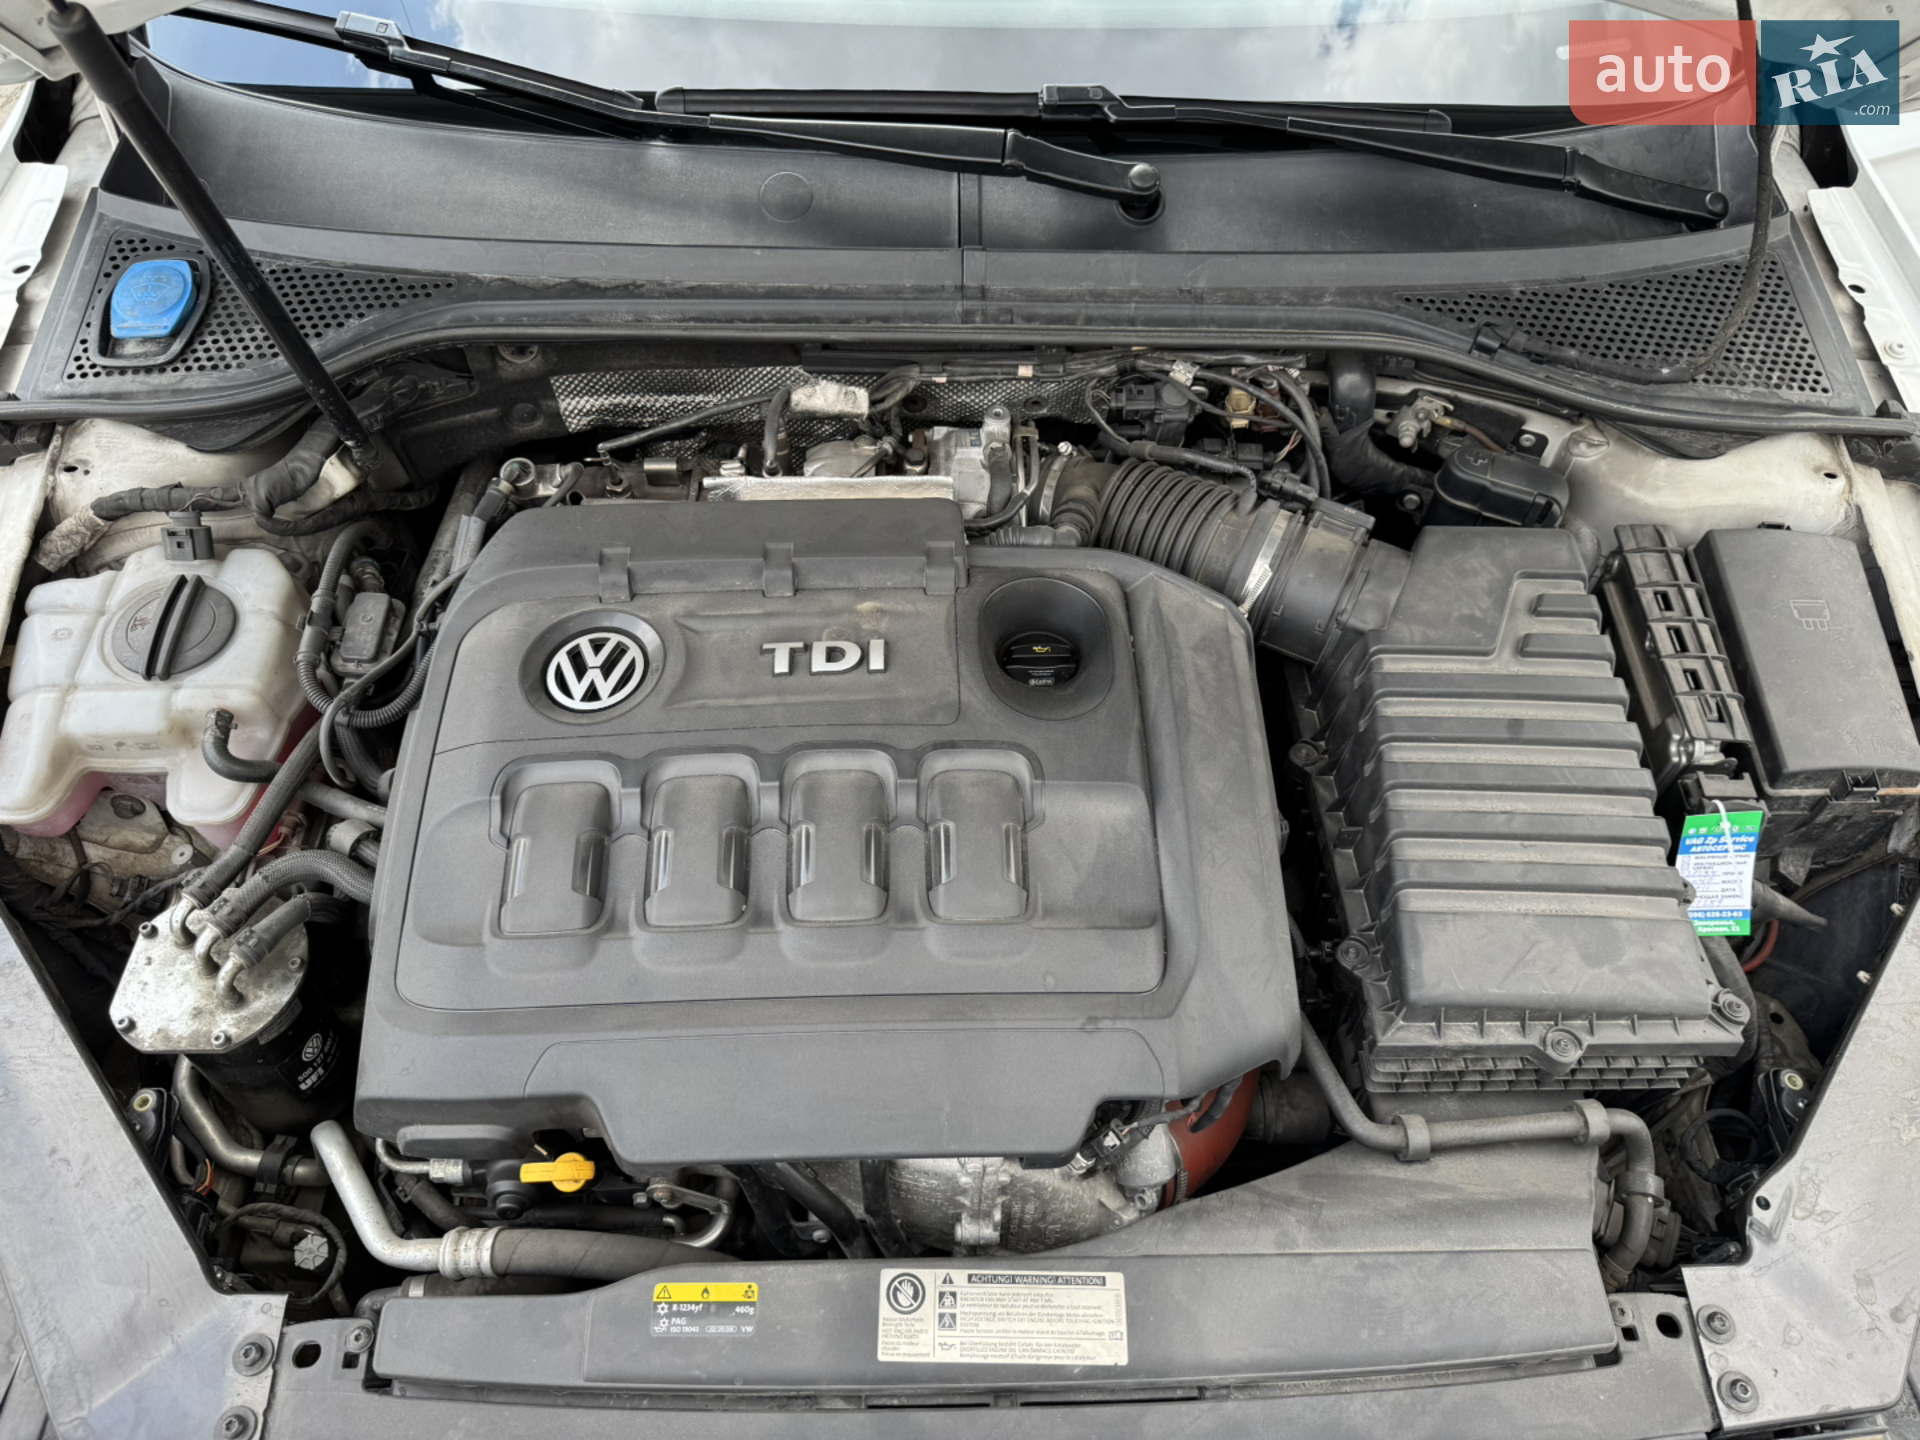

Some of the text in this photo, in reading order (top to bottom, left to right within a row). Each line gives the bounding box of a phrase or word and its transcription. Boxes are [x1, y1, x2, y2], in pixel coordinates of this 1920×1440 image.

[761, 638, 888, 677] TDI
[1719, 834, 1755, 845] Srvice
[1014, 1275, 1056, 1285] WARNING!
[1057, 1276, 1104, 1286] ATTENTION!
[671, 1317, 686, 1325] PAG
